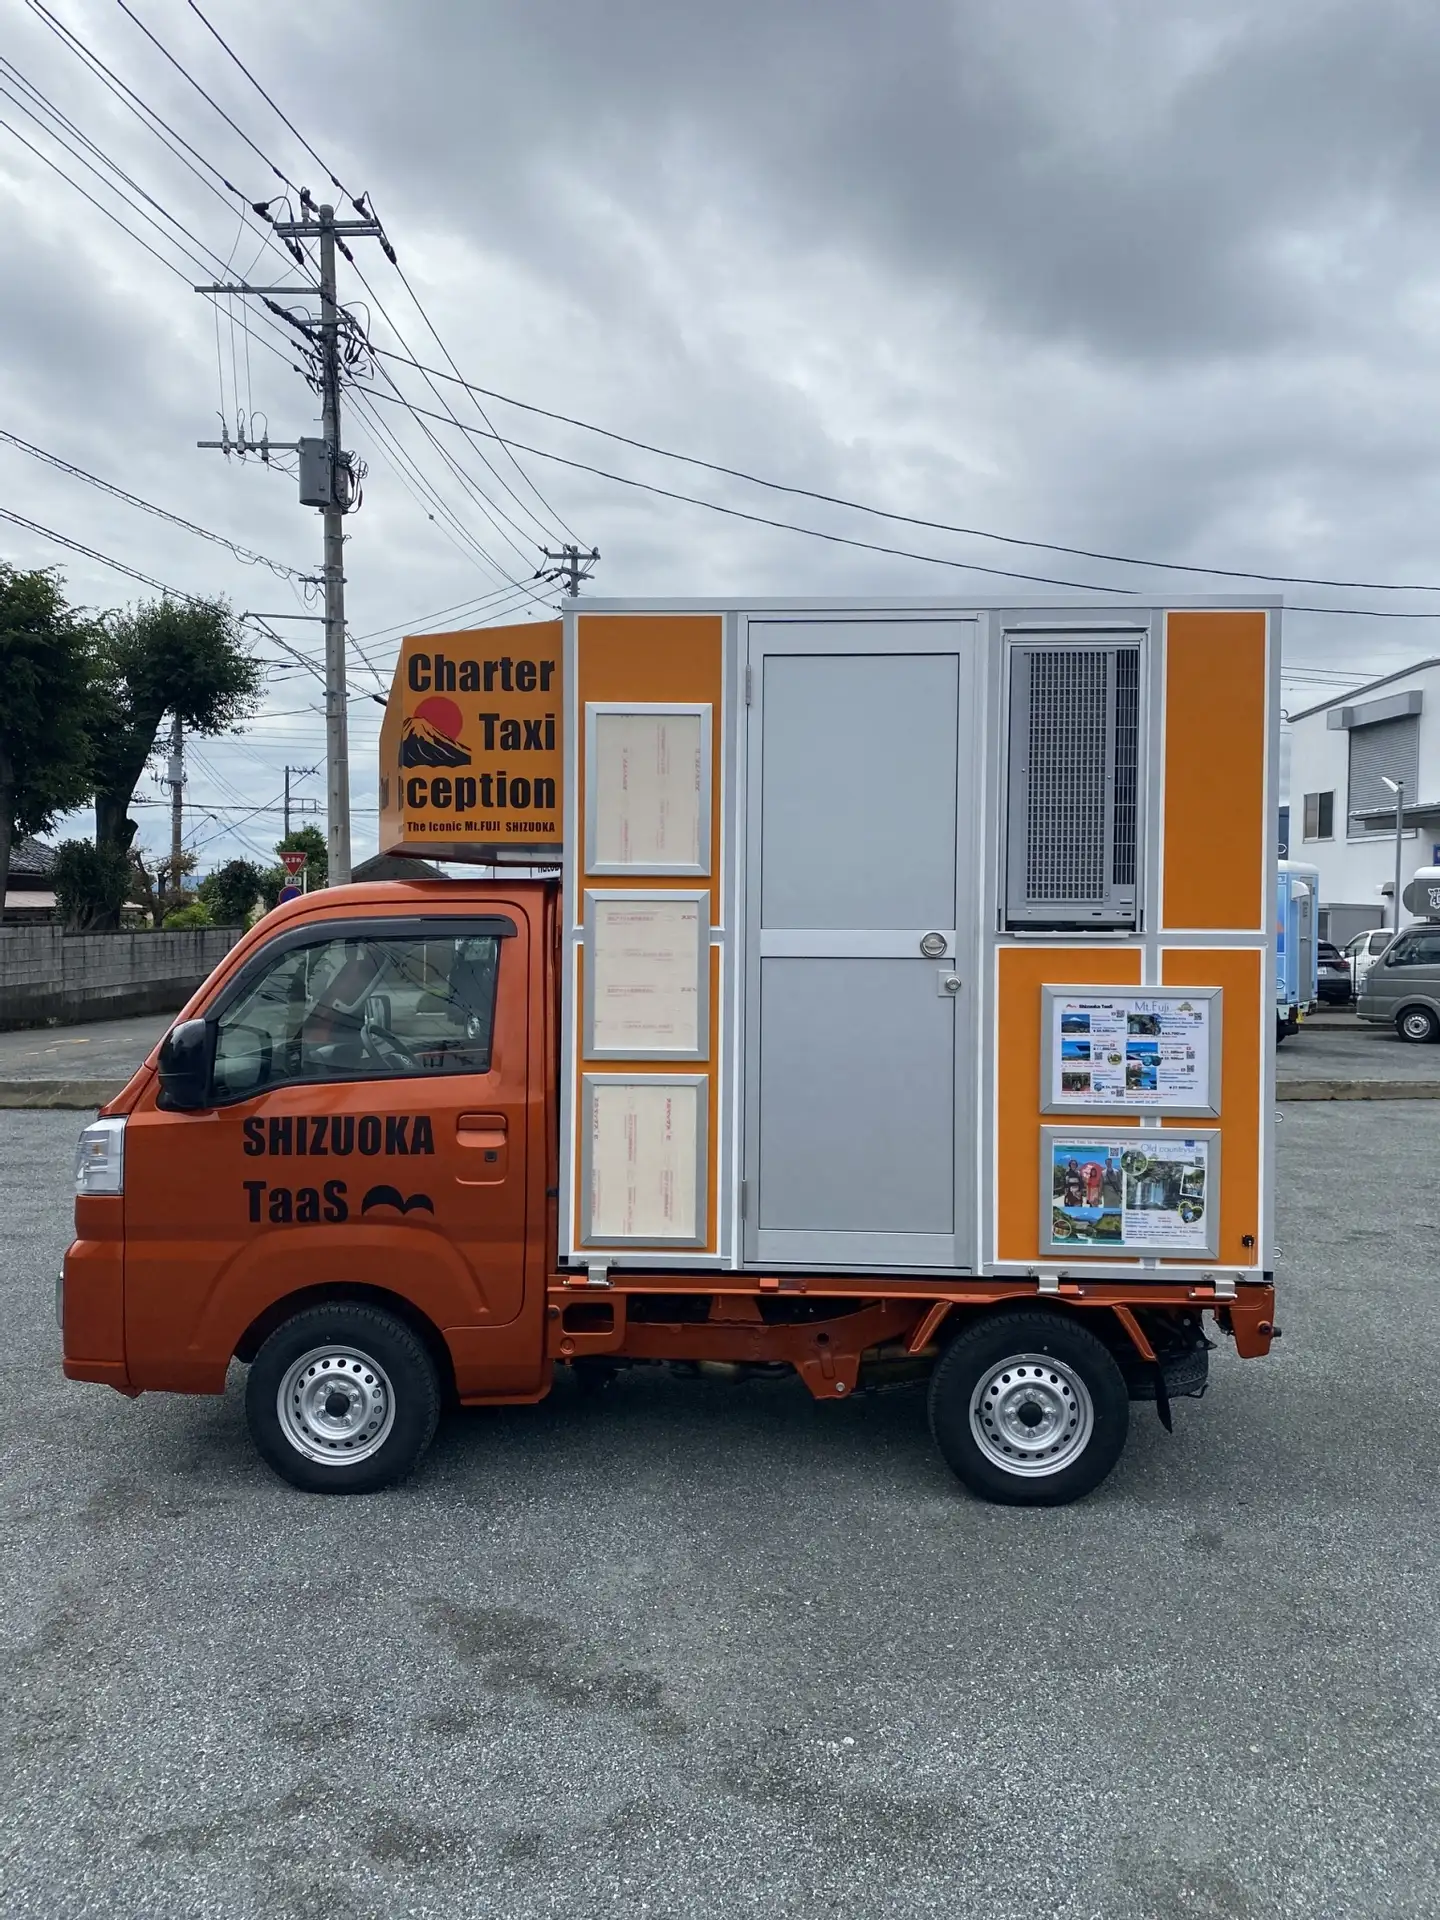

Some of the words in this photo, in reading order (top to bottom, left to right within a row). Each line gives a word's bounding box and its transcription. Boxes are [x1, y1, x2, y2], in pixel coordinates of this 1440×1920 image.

[408, 653, 555, 692] Charter
[478, 713, 555, 751] Taxi
[407, 821, 426, 832] The
[428, 820, 462, 832] Iconic
[505, 821, 555, 832] SHIZUOKA
[243, 1115, 435, 1156] SHIZUOKA
[243, 1179, 349, 1223] TaaS
